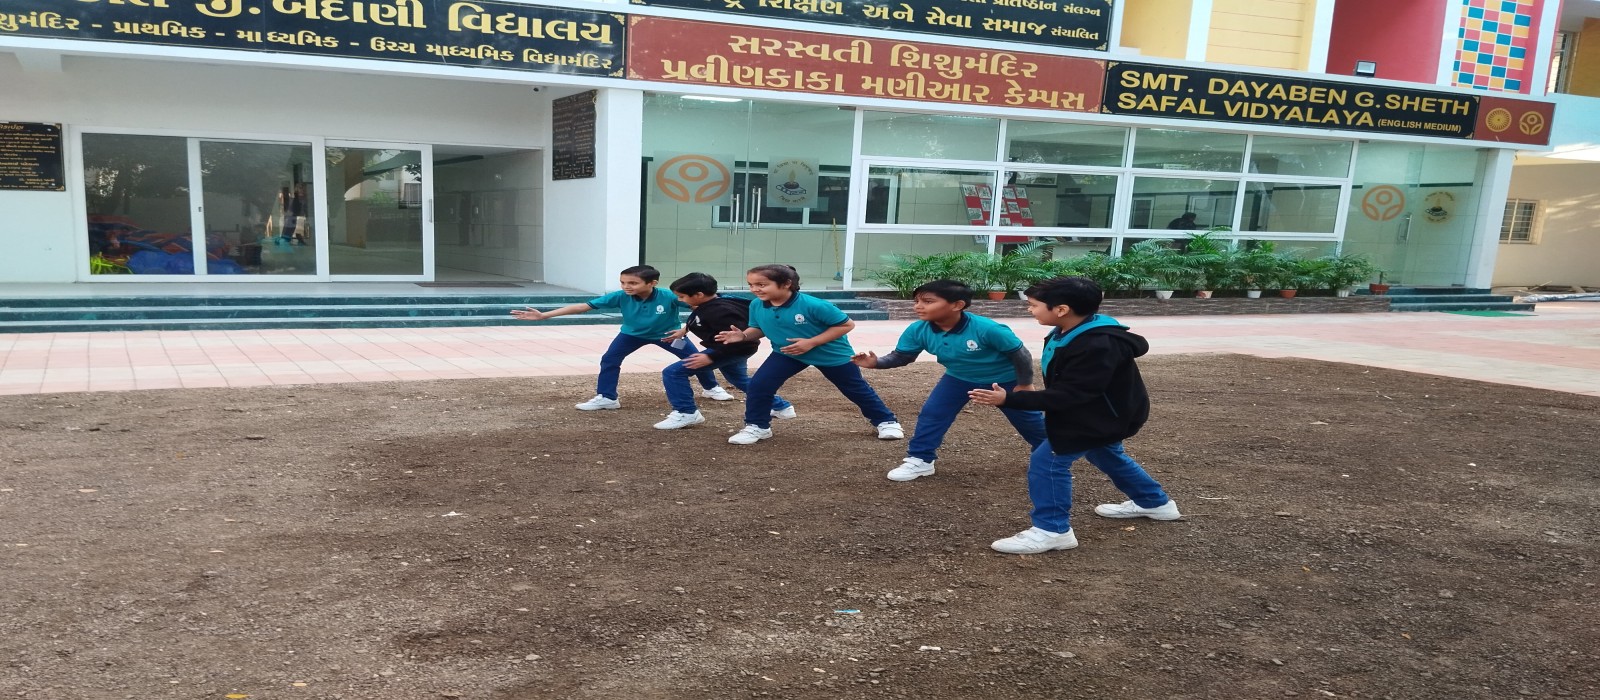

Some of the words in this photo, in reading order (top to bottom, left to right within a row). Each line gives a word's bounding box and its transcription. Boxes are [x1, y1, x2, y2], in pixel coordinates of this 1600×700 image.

[448, 2, 612, 44] વિદ્યાલય
[862, 4, 915, 23] અને
[926, 6, 973, 28] સેવા
[982, 17, 1047, 35] સમાજ
[113, 20, 207, 39] પ્રાથમિક
[370, 36, 417, 54] ઉચ્ચ
[426, 43, 515, 62] માધ્યમિક
[728, 34, 873, 65] સરસ્વતી
[890, 43, 1039, 80] શિશુમંદિર
[661, 54, 845, 93] પ્રવીણકાકા
[861, 72, 991, 103] મણીઆર
[1004, 79, 1086, 110] કેમ્પસ
[1119, 70, 1194, 93] SMT.
[1208, 78, 1348, 106] DAYABEN
[1117, 92, 1215, 115] SAFAL
[1224, 101, 1374, 127] VIDYALAYA
[1377, 117, 1422, 130] (ENGLISH
[1423, 120, 1462, 133] MEDIUM)
